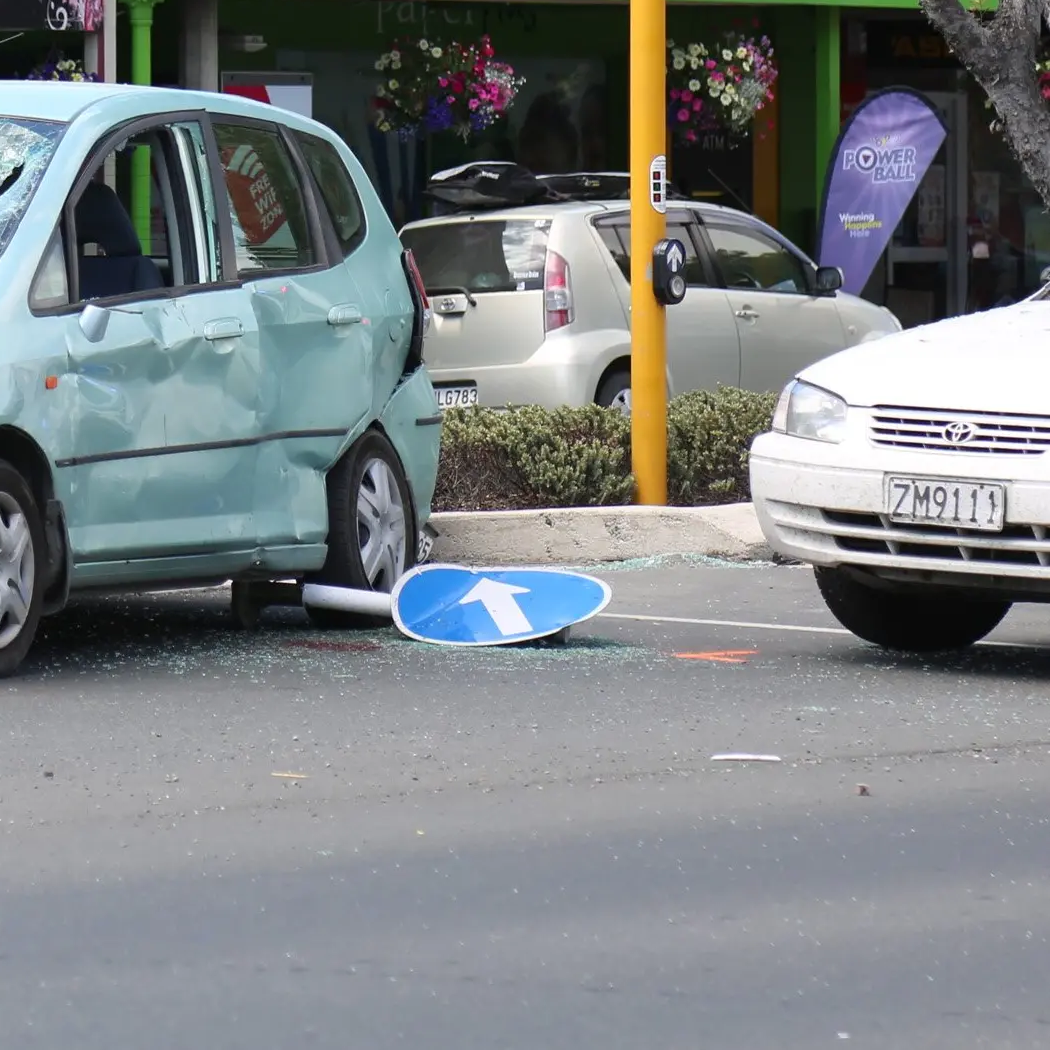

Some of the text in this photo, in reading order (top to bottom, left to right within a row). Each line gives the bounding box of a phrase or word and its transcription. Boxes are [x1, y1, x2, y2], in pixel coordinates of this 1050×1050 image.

[843, 146, 917, 173] POWER
[872, 164, 916, 184] BALL
[838, 211, 876, 223] Winning
[434, 388, 478, 406] LG783
[892, 483, 997, 525] ZM9111
